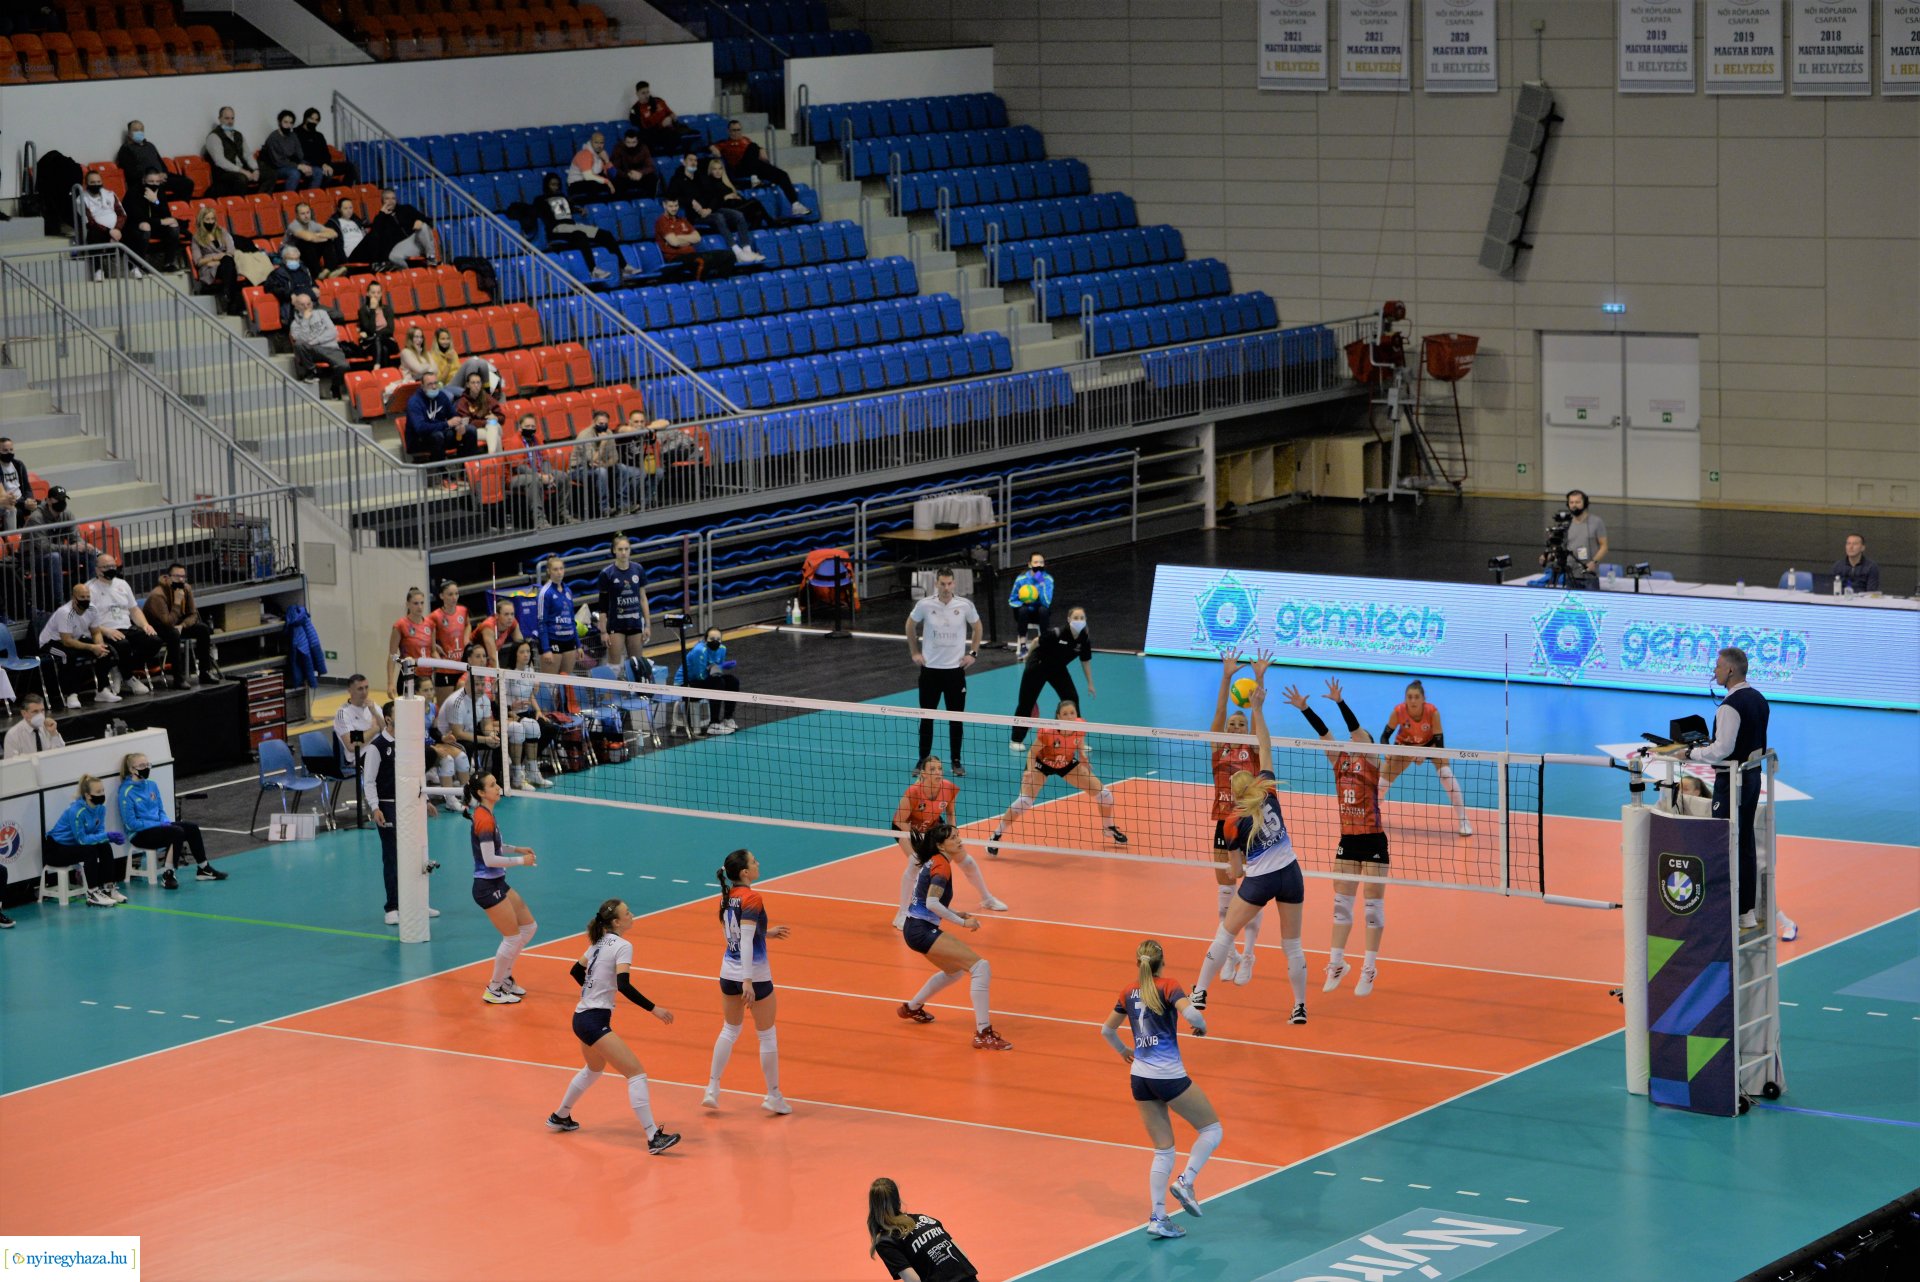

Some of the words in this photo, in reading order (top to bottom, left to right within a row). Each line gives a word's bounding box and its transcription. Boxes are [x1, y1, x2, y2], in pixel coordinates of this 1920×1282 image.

[1815, 16, 1847, 24] CSAPATA
[1450, 32, 1470, 42] 2020
[1646, 30, 1667, 40] 2019
[1733, 31, 1755, 42] 2019
[1821, 30, 1842, 41] 2018
[1347, 45, 1379, 55] MAGYAR
[1381, 46, 1402, 55] KUPA
[1432, 45, 1465, 56] MAGYAR
[1467, 46, 1488, 56] KUPA
[1625, 44, 1651, 54] MAGYAR
[1713, 46, 1749, 56] MAGYAR
[1751, 46, 1775, 56] KUPA
[1798, 46, 1825, 55] MAGYAR
[1827, 42, 1864, 56] BAJNOKSÁG
[1890, 46, 1920, 56] MAGYA
[1811, 60, 1864, 75] HELYEZÉS
[1275, 601, 1446, 642] gemtech
[1621, 625, 1807, 669] gemtech
[1343, 788, 1356, 804] 18
[1668, 858, 1689, 869] CEV
[1134, 1001, 1147, 1035] 7
